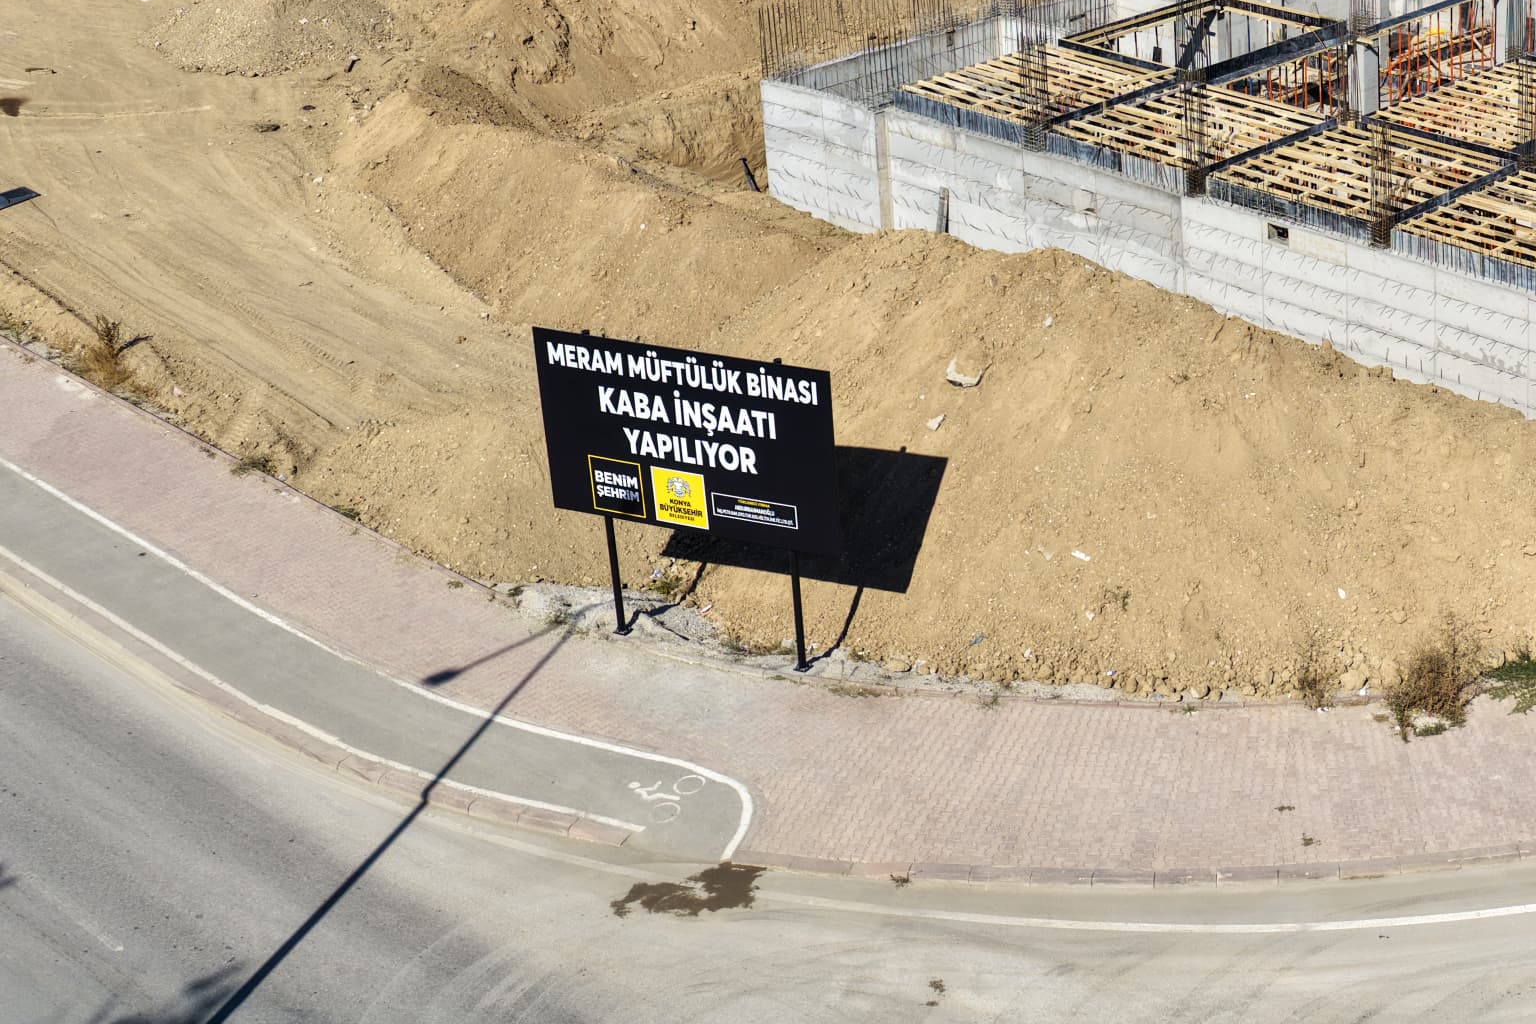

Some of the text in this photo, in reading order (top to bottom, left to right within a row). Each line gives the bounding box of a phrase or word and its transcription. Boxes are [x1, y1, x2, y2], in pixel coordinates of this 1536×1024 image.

[546, 341, 818, 406] MERAM MÜFTÜLÜK BİNASI
[598, 385, 777, 440] KABA İNŞAATI
[622, 427, 758, 475] YAPILIYOR
[669, 498, 692, 508] KONYA
